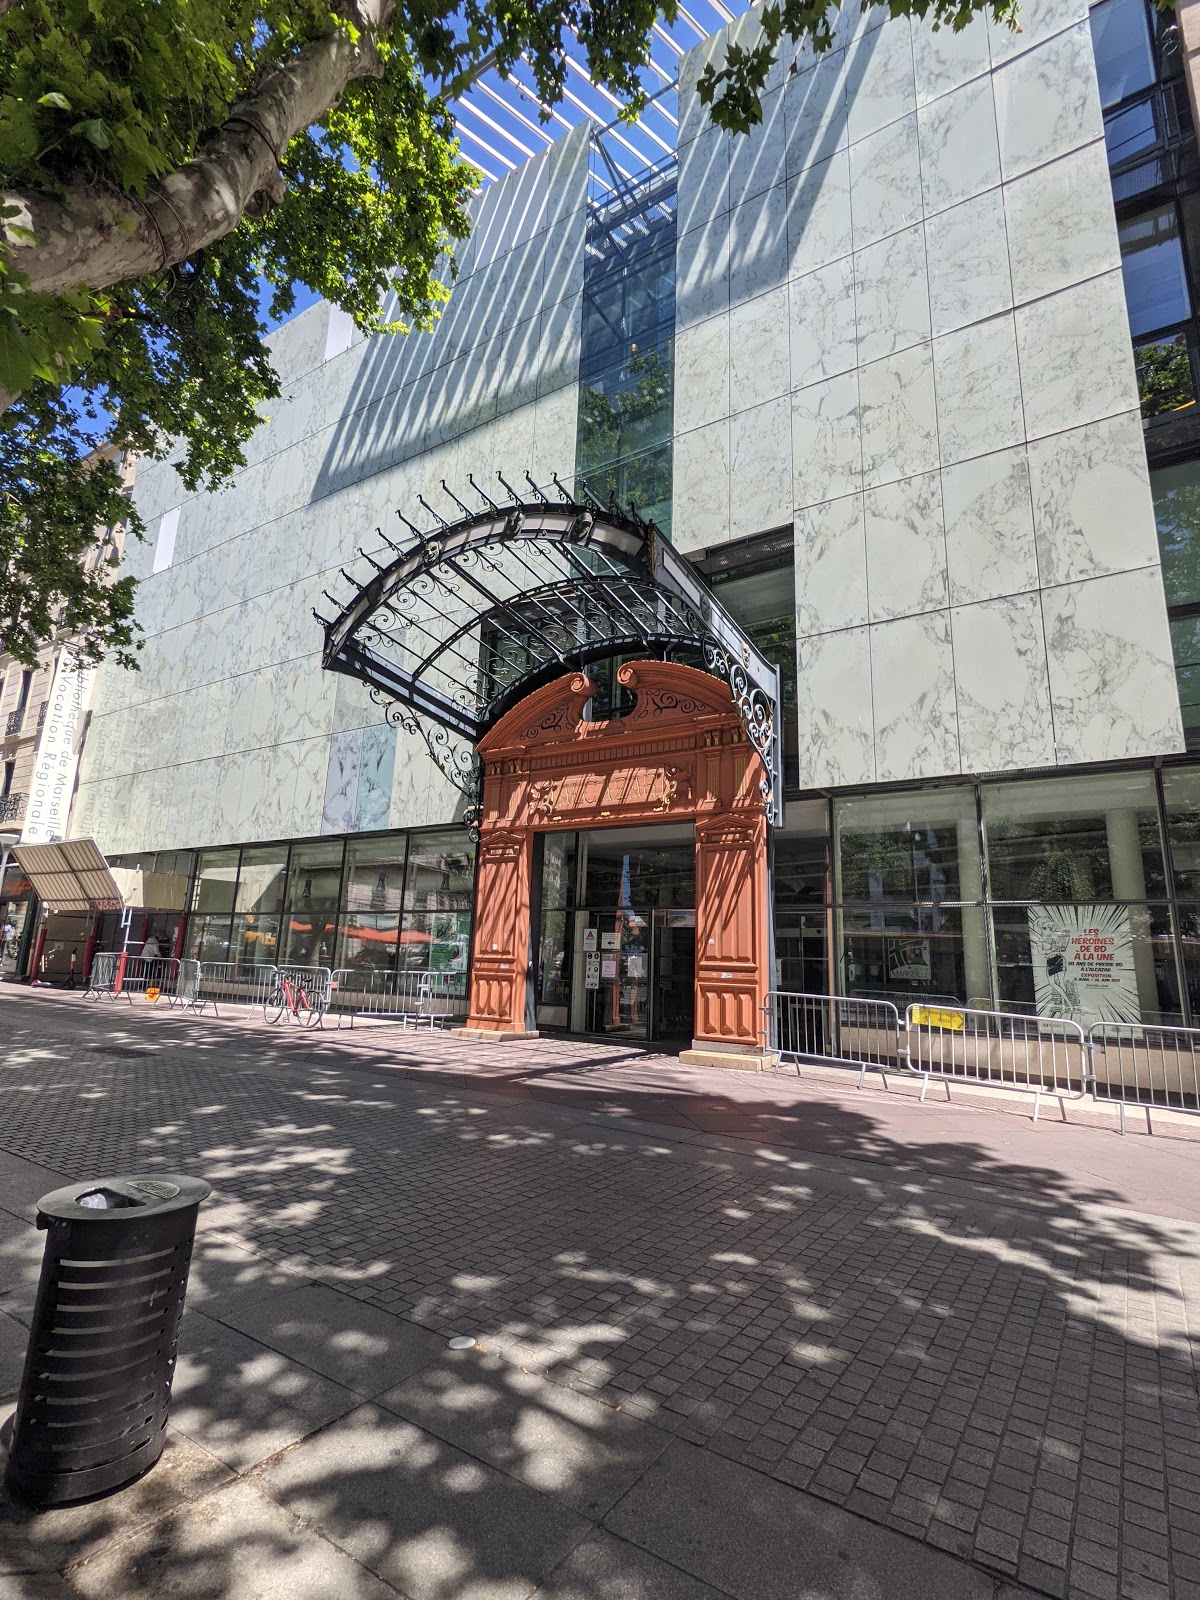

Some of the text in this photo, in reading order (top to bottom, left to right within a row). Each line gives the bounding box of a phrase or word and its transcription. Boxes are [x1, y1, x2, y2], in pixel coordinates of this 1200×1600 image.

[49, 676, 74, 743] Vocation
[59, 750, 73, 768] de
[556, 774, 658, 807] ALCAZAR
[28, 751, 58, 835] Régionale
[45, 772, 68, 838] Marseille
